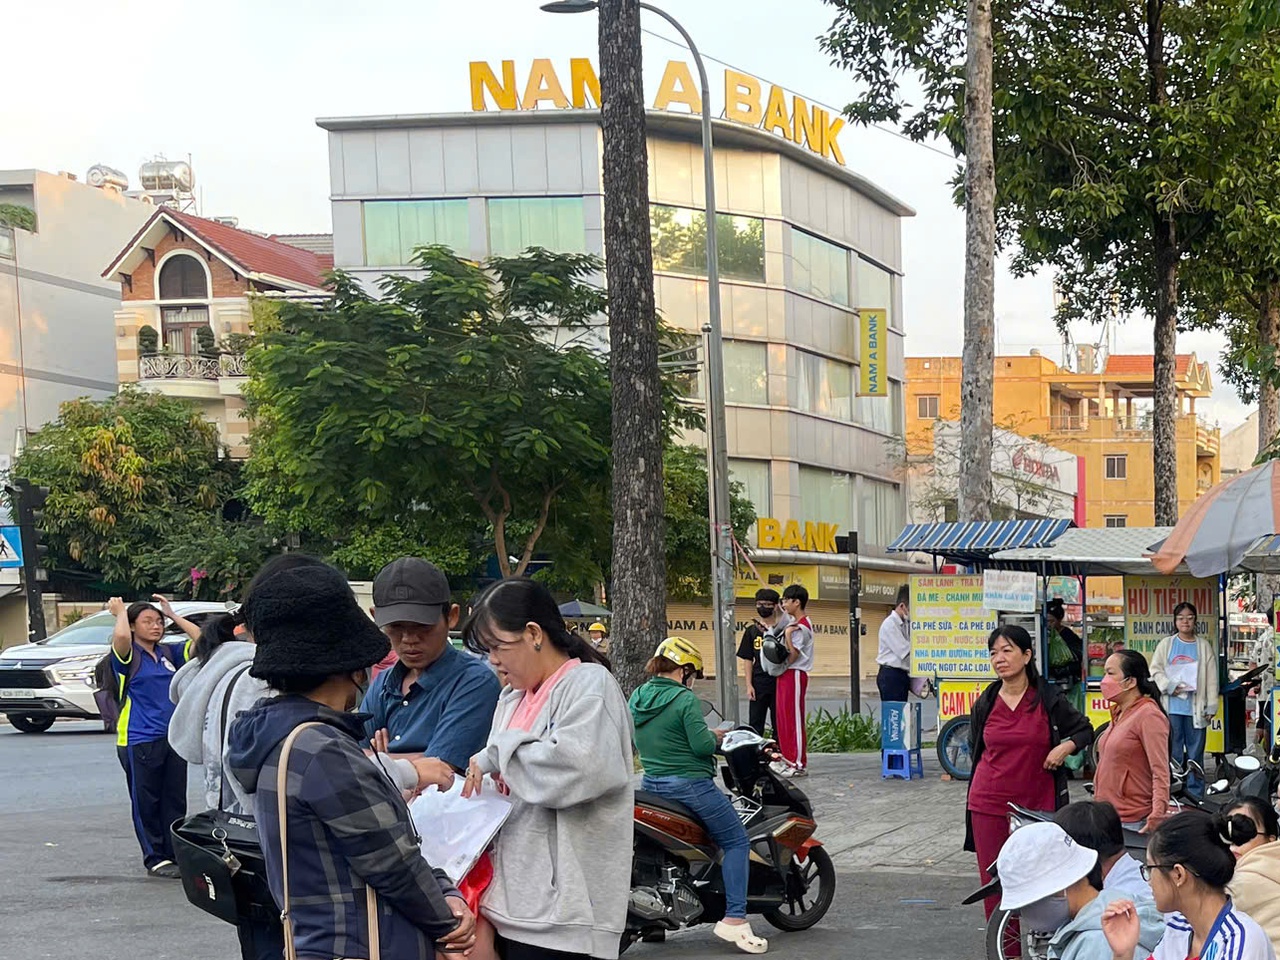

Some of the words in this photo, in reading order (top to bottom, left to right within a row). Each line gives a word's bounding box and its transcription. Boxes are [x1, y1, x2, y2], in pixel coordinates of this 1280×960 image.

[469, 58, 600, 111] NAM
[653, 60, 702, 113] A
[725, 69, 845, 165] BANK
[868, 314, 878, 349] BANK
[868, 351, 878, 361] A
[868, 363, 878, 392] NAM
[757, 518, 838, 553] BANK
[1128, 580, 1149, 614] HỦ
[667, 620, 696, 631] NAM
[699, 620, 709, 631] A
[812, 624, 822, 634] AM
[830, 625, 848, 635] BANK
[942, 692, 966, 715] CAM
[1211, 720, 1222, 730] LA
